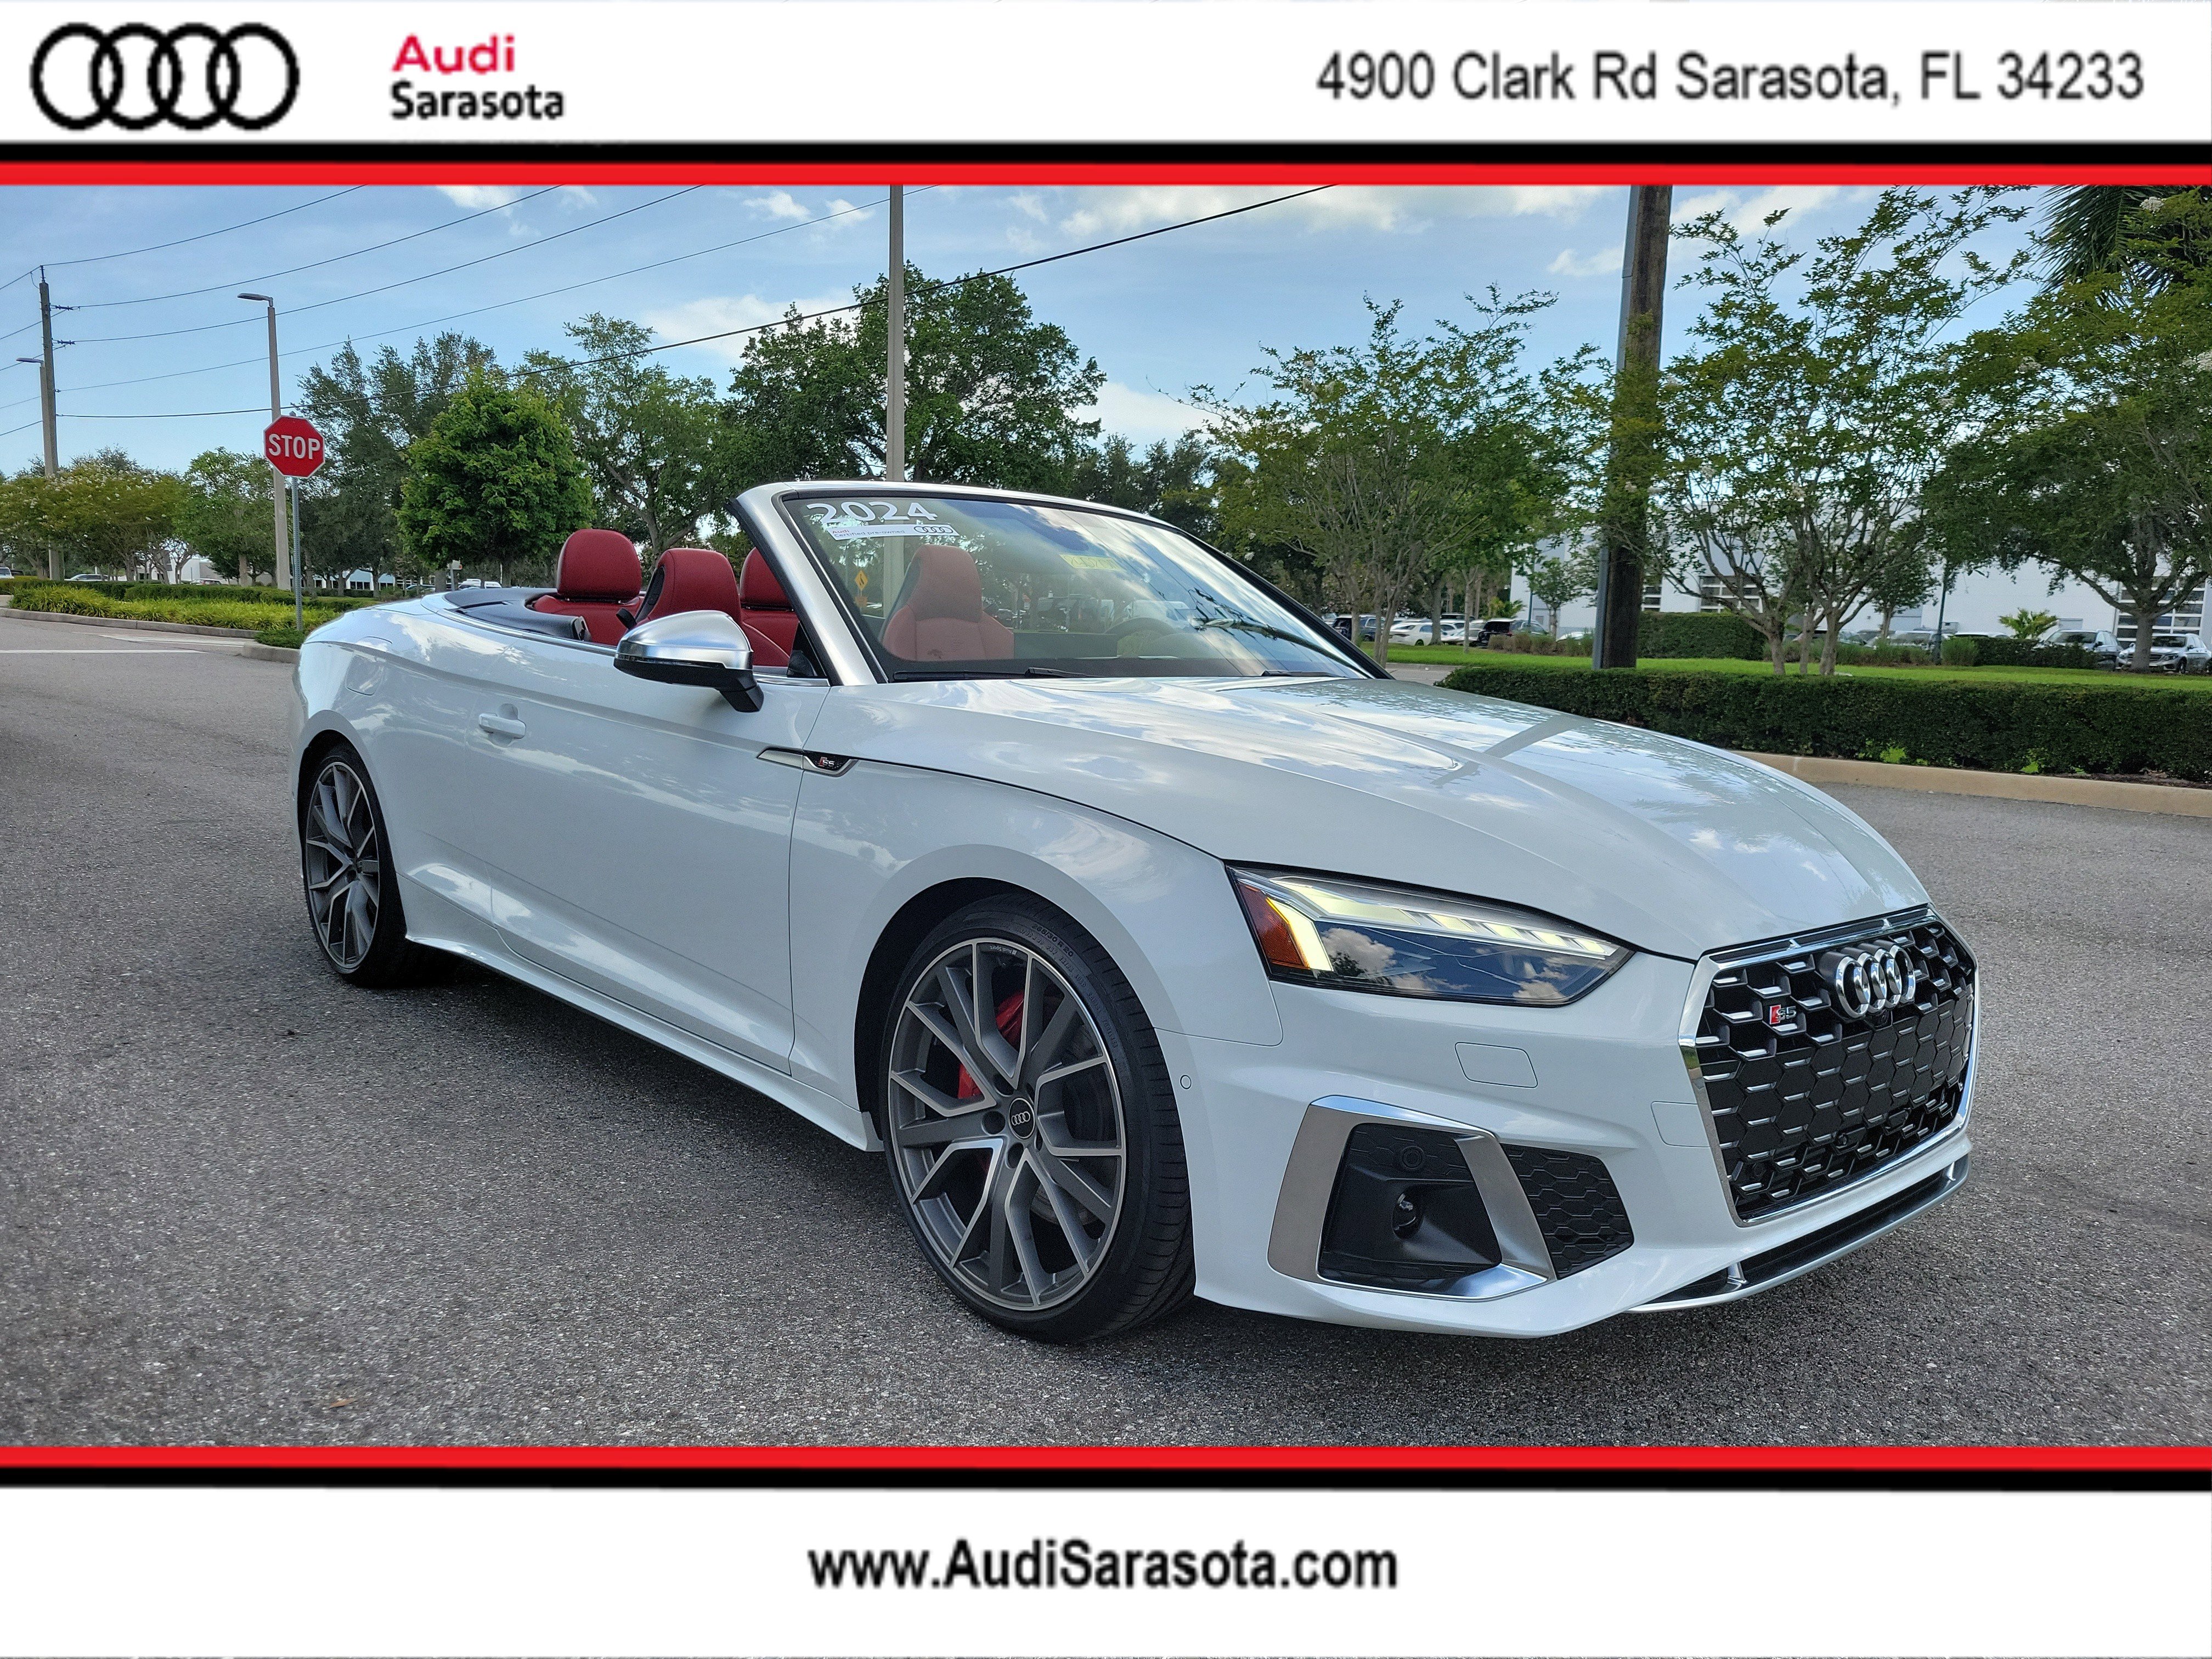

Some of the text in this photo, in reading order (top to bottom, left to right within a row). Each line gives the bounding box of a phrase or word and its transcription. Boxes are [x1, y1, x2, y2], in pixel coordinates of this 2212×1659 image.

[268, 433, 321, 460] STOP
[806, 501, 938, 524] 2024
[1774, 1005, 1797, 1021] S5
